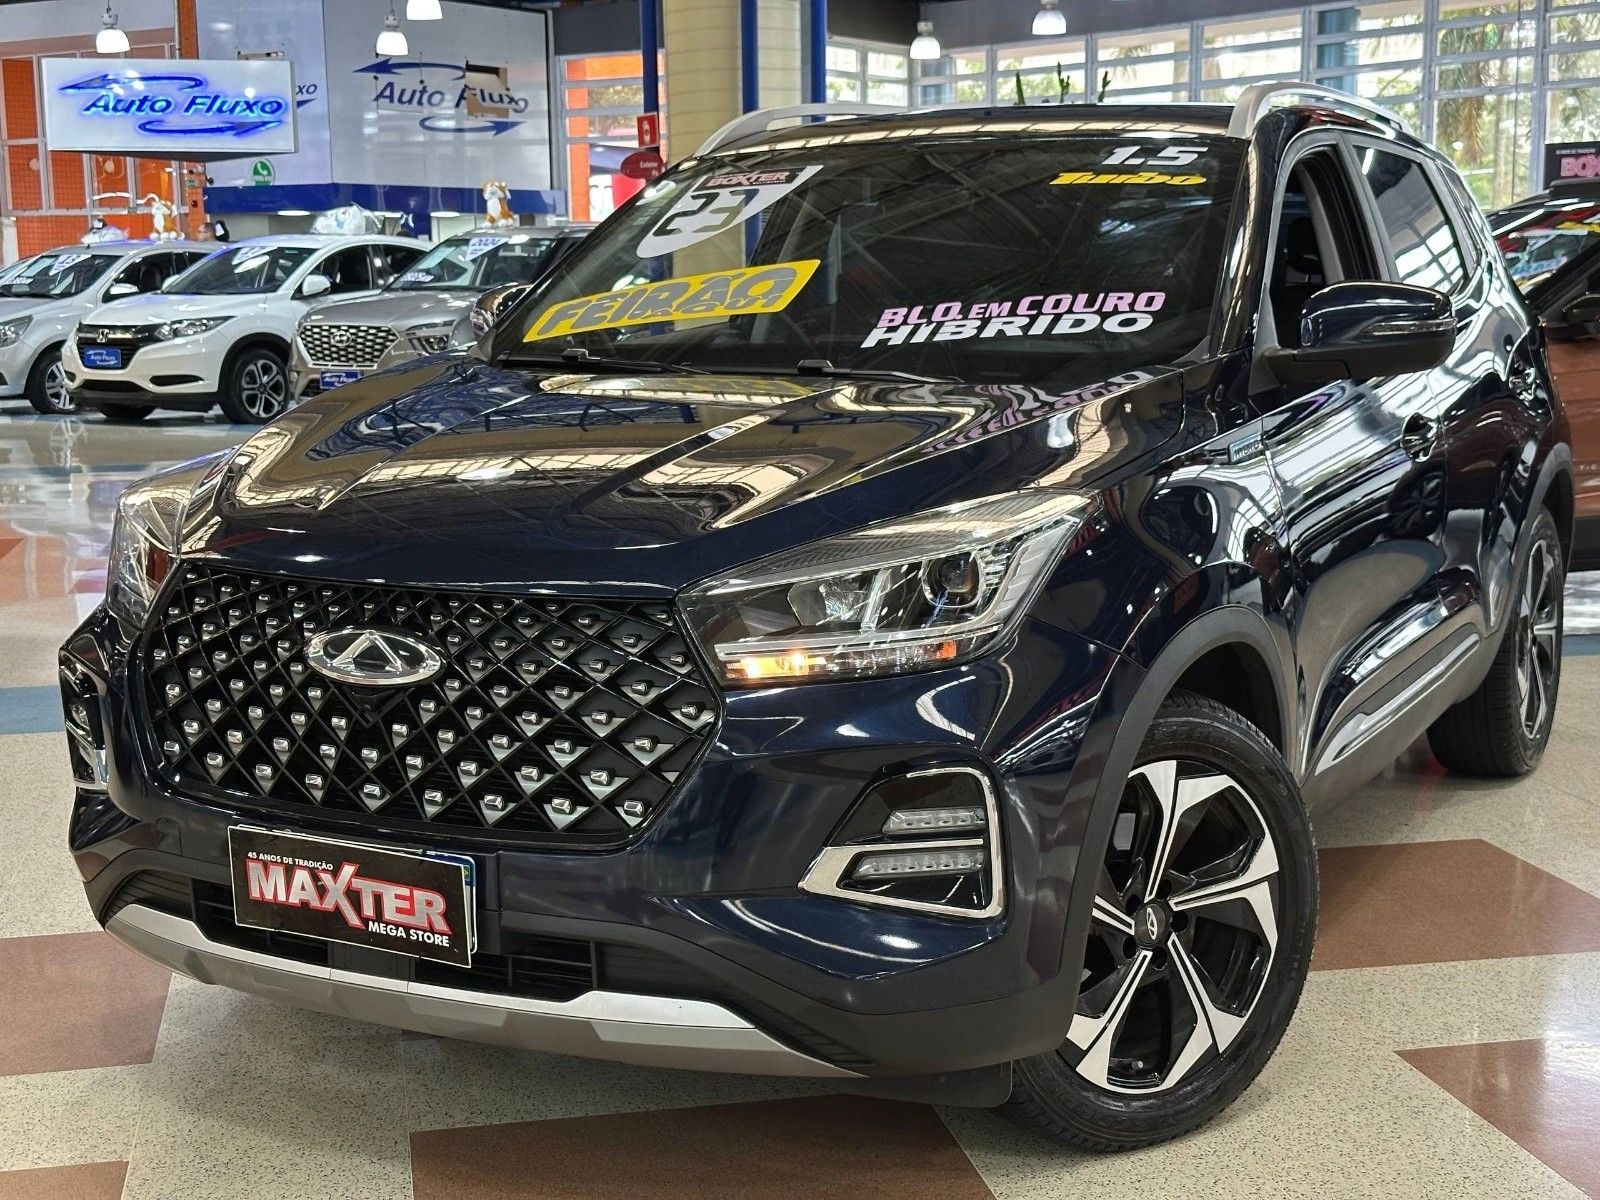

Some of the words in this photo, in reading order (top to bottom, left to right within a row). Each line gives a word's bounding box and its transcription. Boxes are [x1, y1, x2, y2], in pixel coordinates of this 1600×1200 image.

[83, 94, 172, 114] Auto
[184, 95, 284, 116] Fluxo
[372, 81, 446, 107] Auto
[454, 83, 530, 114] Fluxo
[1101, 145, 1209, 166] 1.5
[704, 170, 790, 187] BOXTER
[1048, 171, 1208, 185] Turbo
[652, 188, 760, 237] 23
[967, 302, 1013, 319] EM
[1015, 291, 1166, 316] COURO
[247, 851, 258, 860] 45
[258, 853, 282, 864] ANOS
[282, 856, 294, 866] DE
[294, 858, 334, 872] TRADIÇÃO
[246, 860, 452, 935] MAXTER
[368, 920, 407, 938] MEGA
[409, 928, 450, 948] STORE
